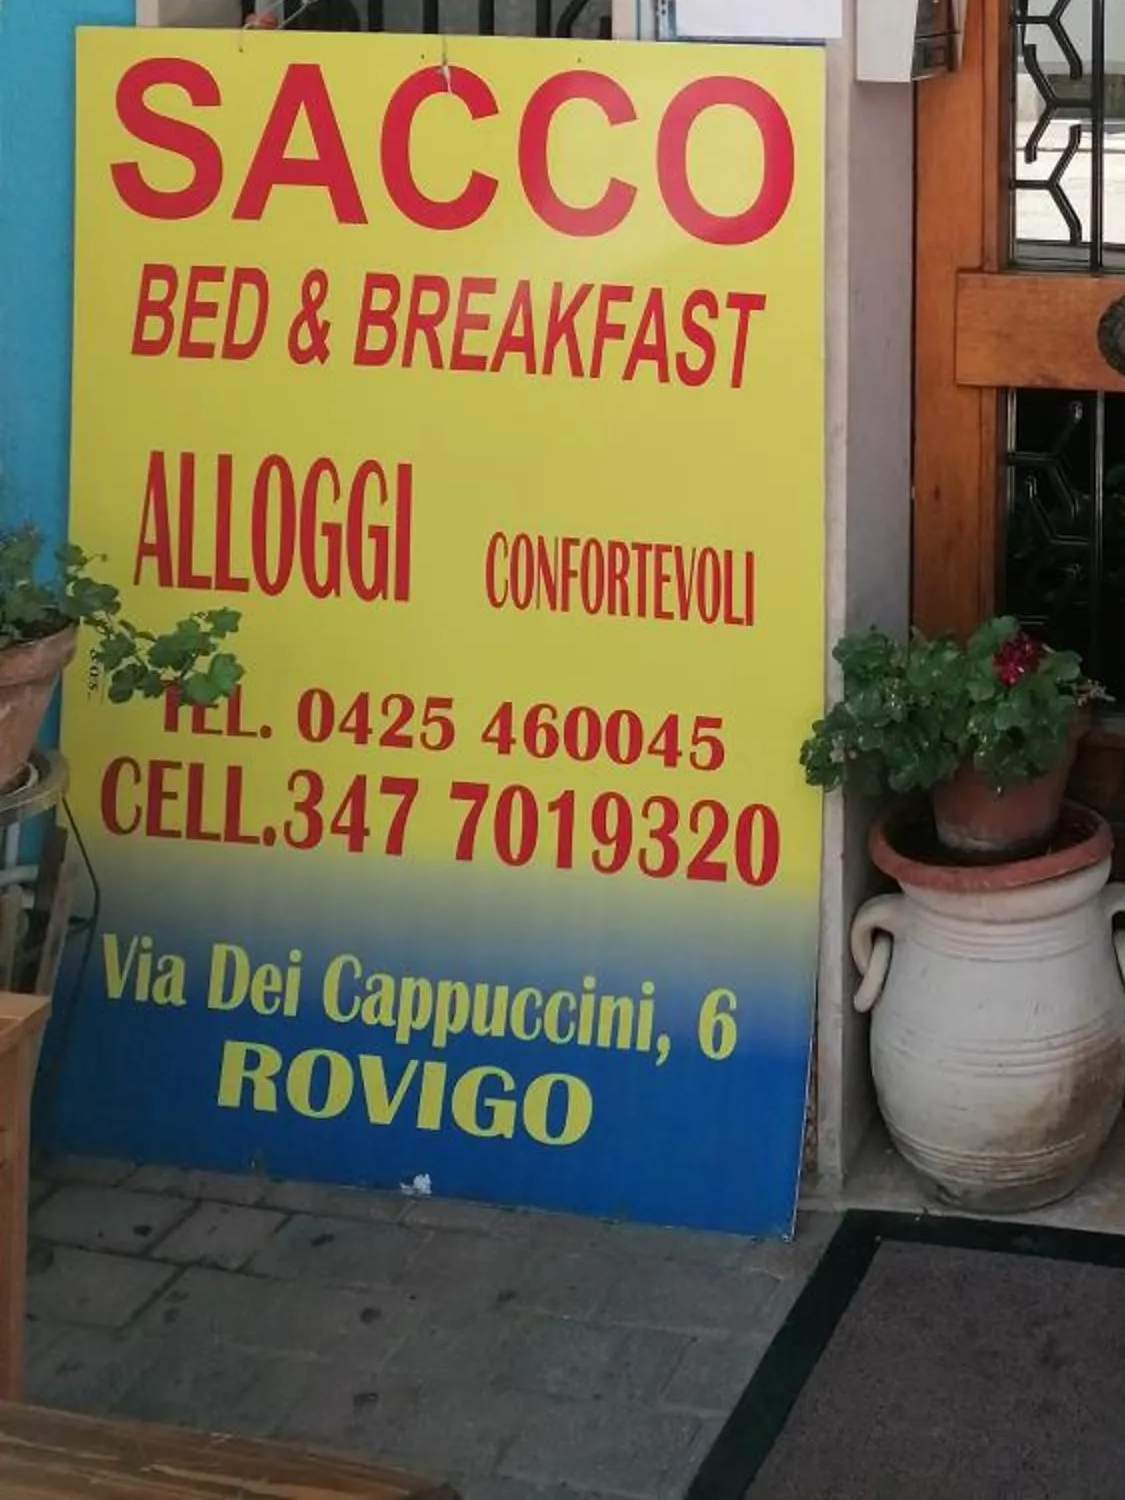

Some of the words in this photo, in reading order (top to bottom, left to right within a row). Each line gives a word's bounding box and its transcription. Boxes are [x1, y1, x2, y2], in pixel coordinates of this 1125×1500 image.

[110, 57, 795, 246] SACCO
[131, 263, 270, 361] BED
[287, 269, 331, 366] &
[352, 272, 766, 389] BREAKFAST
[133, 450, 412, 602] ALLOGGI
[485, 531, 755, 627] CONFORTEVOLI
[296, 688, 456, 751] 0425
[481, 701, 726, 771] 460045
[449, 780, 781, 887] 7019320
[102, 933, 186, 1006] Via
[207, 943, 302, 1018] Dei
[322, 954, 672, 1067] Cappuccini,
[698, 989, 738, 1060] 6
[216, 1040, 593, 1146] ROVIGO
